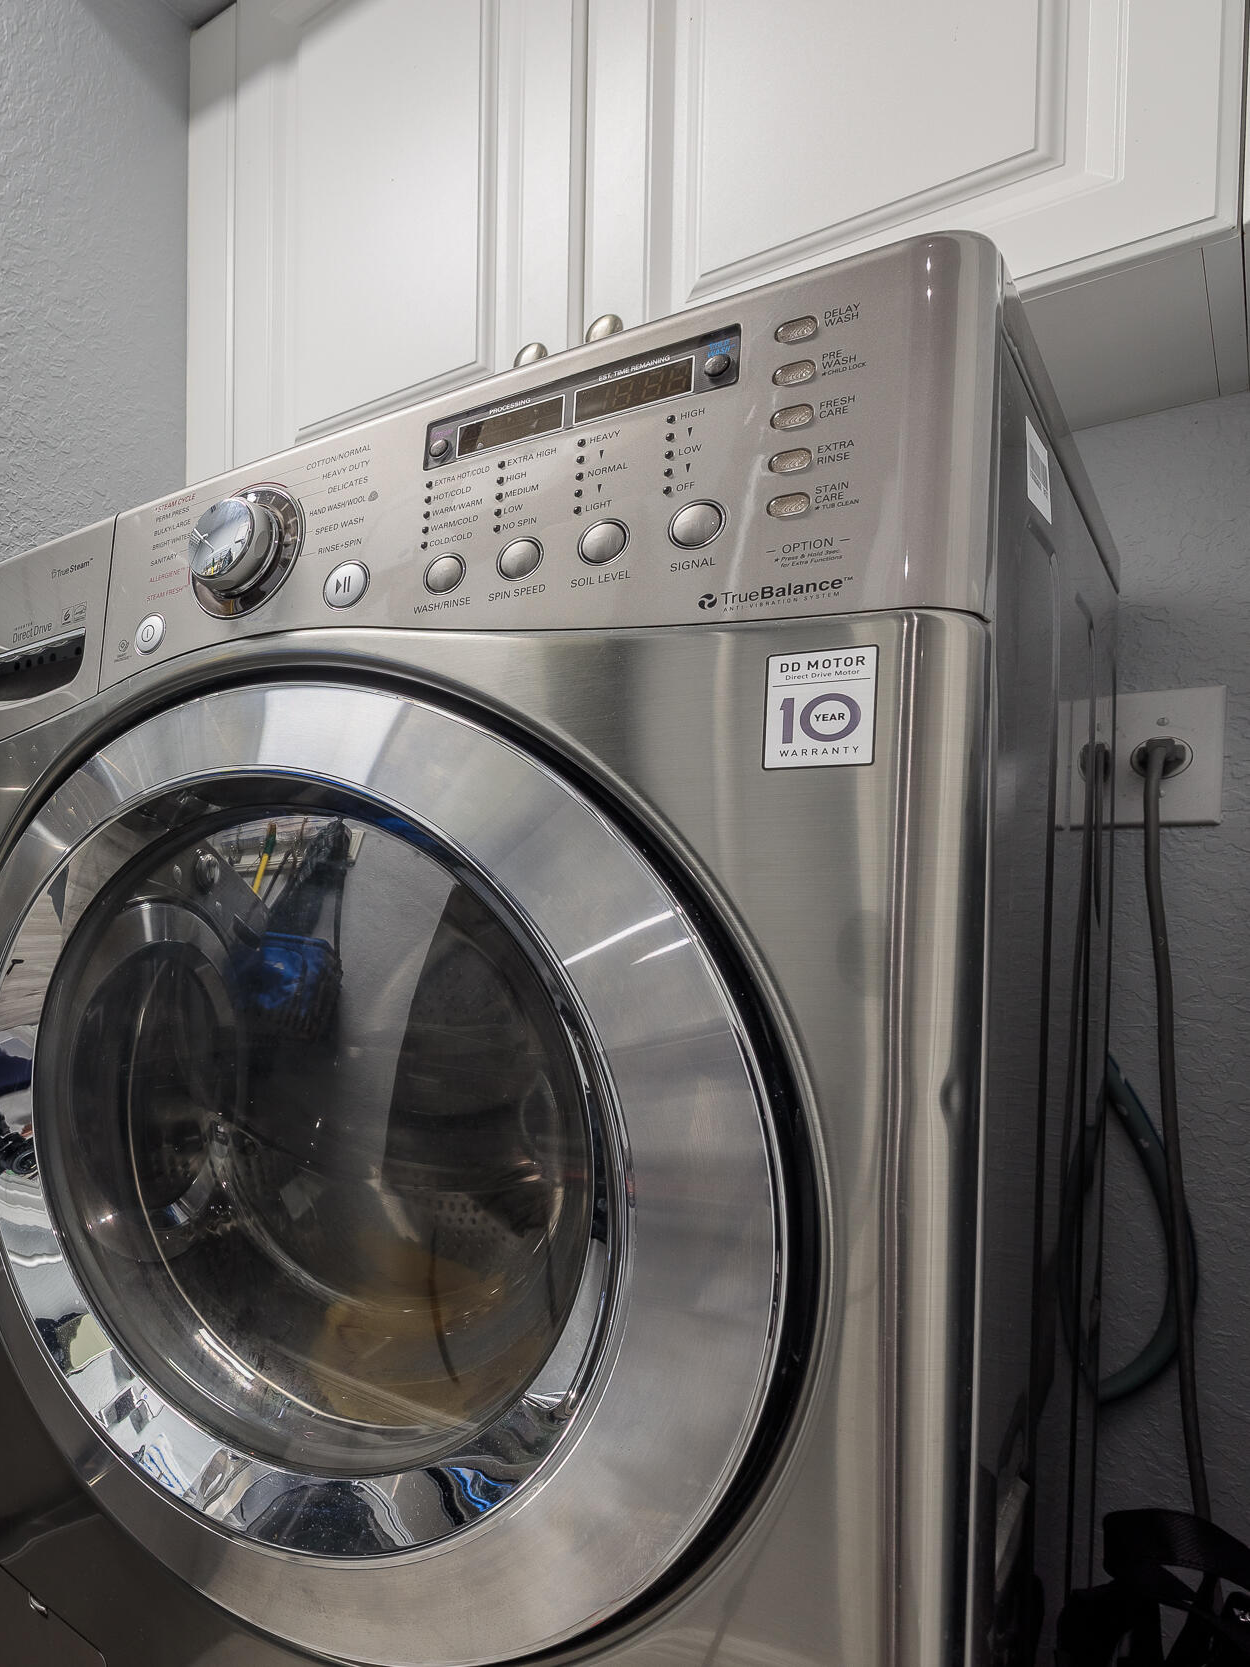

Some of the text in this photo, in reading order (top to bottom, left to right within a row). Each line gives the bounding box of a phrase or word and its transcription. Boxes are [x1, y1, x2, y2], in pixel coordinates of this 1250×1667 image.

[824, 302, 861, 320] DELAY
[824, 312, 859, 327] WASH
[822, 349, 842, 362] PRE
[822, 354, 856, 370] WASH
[614, 368, 629, 377] TIME
[630, 355, 671, 372] REMAINING
[828, 361, 867, 376] CHILD LOCK
[488, 398, 532, 415] PROCESSING
[820, 394, 855, 410] FRESH
[680, 408, 706, 421] HIGH
[819, 406, 849, 419] CARE
[588, 430, 621, 445] HEAVY
[678, 444, 702, 457] LOW
[817, 440, 855, 454] EXTRA
[306, 444, 372, 471] COTTON/NORMAL
[507, 448, 557, 466] EXTRA HIGH
[817, 452, 850, 465] RINSE
[322, 460, 370, 480] HEAVY DUTY
[434, 466, 490, 487] EXTRA HOT/COLD
[506, 472, 527, 483] HIGH
[587, 462, 628, 478] NORMAL
[327, 476, 369, 494] DELICATES
[504, 484, 539, 499] MEDIUM
[676, 481, 695, 492] OFF
[815, 481, 849, 494] STAIN
[433, 486, 472, 502] HOT/COLD
[815, 492, 844, 504] CARE
[310, 495, 366, 517] HAND WASH/WOOL
[432, 498, 483, 516] WARM/WARM
[504, 504, 524, 515] LOW
[584, 500, 612, 513] LIGHT
[836, 499, 860, 508] CLEAN
[315, 516, 365, 535] SPEED WASH
[430, 514, 478, 532] WARM/COLD
[502, 516, 537, 531] NO SPIN
[152, 533, 190, 551] BRIGHT WHITES
[318, 537, 363, 555] RINSE+SPIN
[429, 532, 473, 547] COLD/COLD
[782, 537, 834, 554] OPTION
[150, 553, 178, 567] SANITARY
[670, 557, 716, 572] SIGNAL
[781, 554, 799, 562] Press
[810, 555, 843, 563] Functions
[570, 570, 631, 588] SOIL LEVEL
[146, 592, 165, 602] STEAM
[488, 584, 546, 602] SPIN SPEED
[803, 592, 840, 601] SYSTEM
[413, 597, 471, 615] WASH/RINSE
[13, 622, 52, 643] Direct Drive
[780, 656, 866, 673] DD MOTOR
[779, 693, 861, 744] 10
[814, 712, 846, 722] YEAR
[779, 746, 859, 757] WARRANTY
